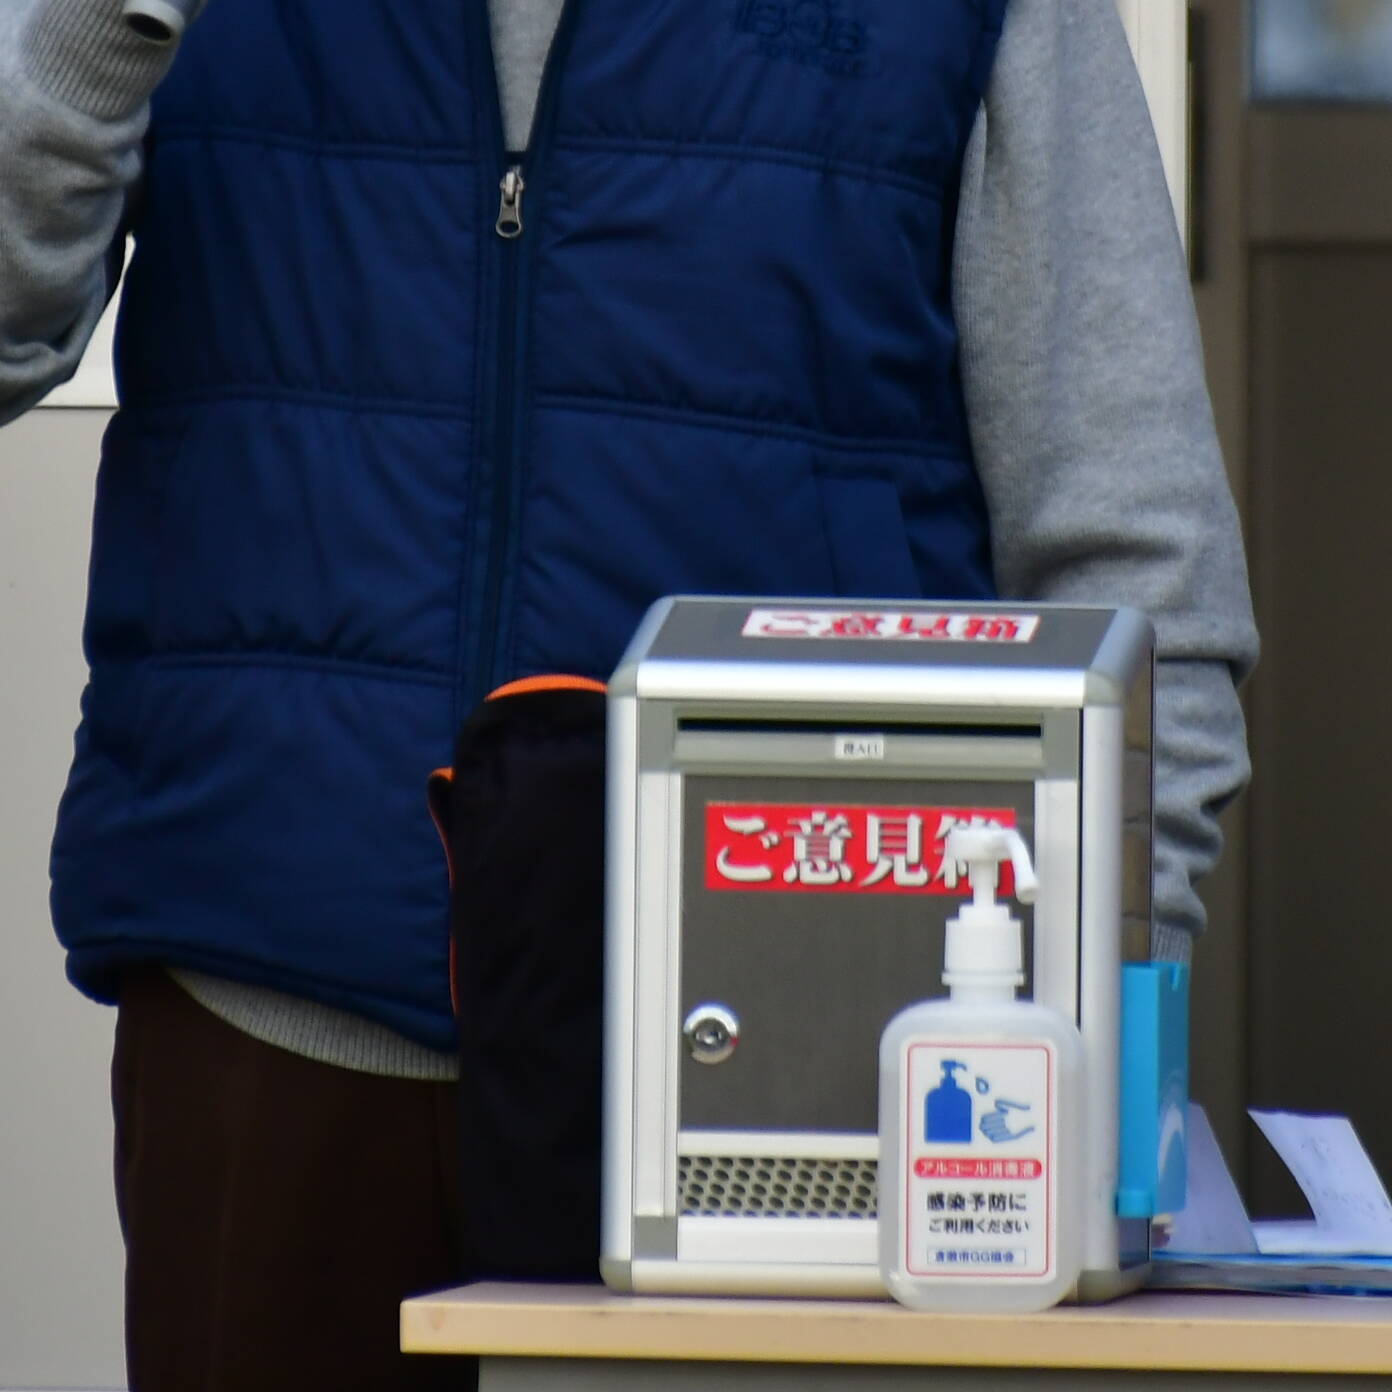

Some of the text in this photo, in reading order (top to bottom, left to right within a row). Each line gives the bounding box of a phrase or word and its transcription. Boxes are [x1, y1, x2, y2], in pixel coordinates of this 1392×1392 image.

[927, 1191, 1027, 1212] 感染予防に
[929, 1218, 1029, 1234] ご利用ください
